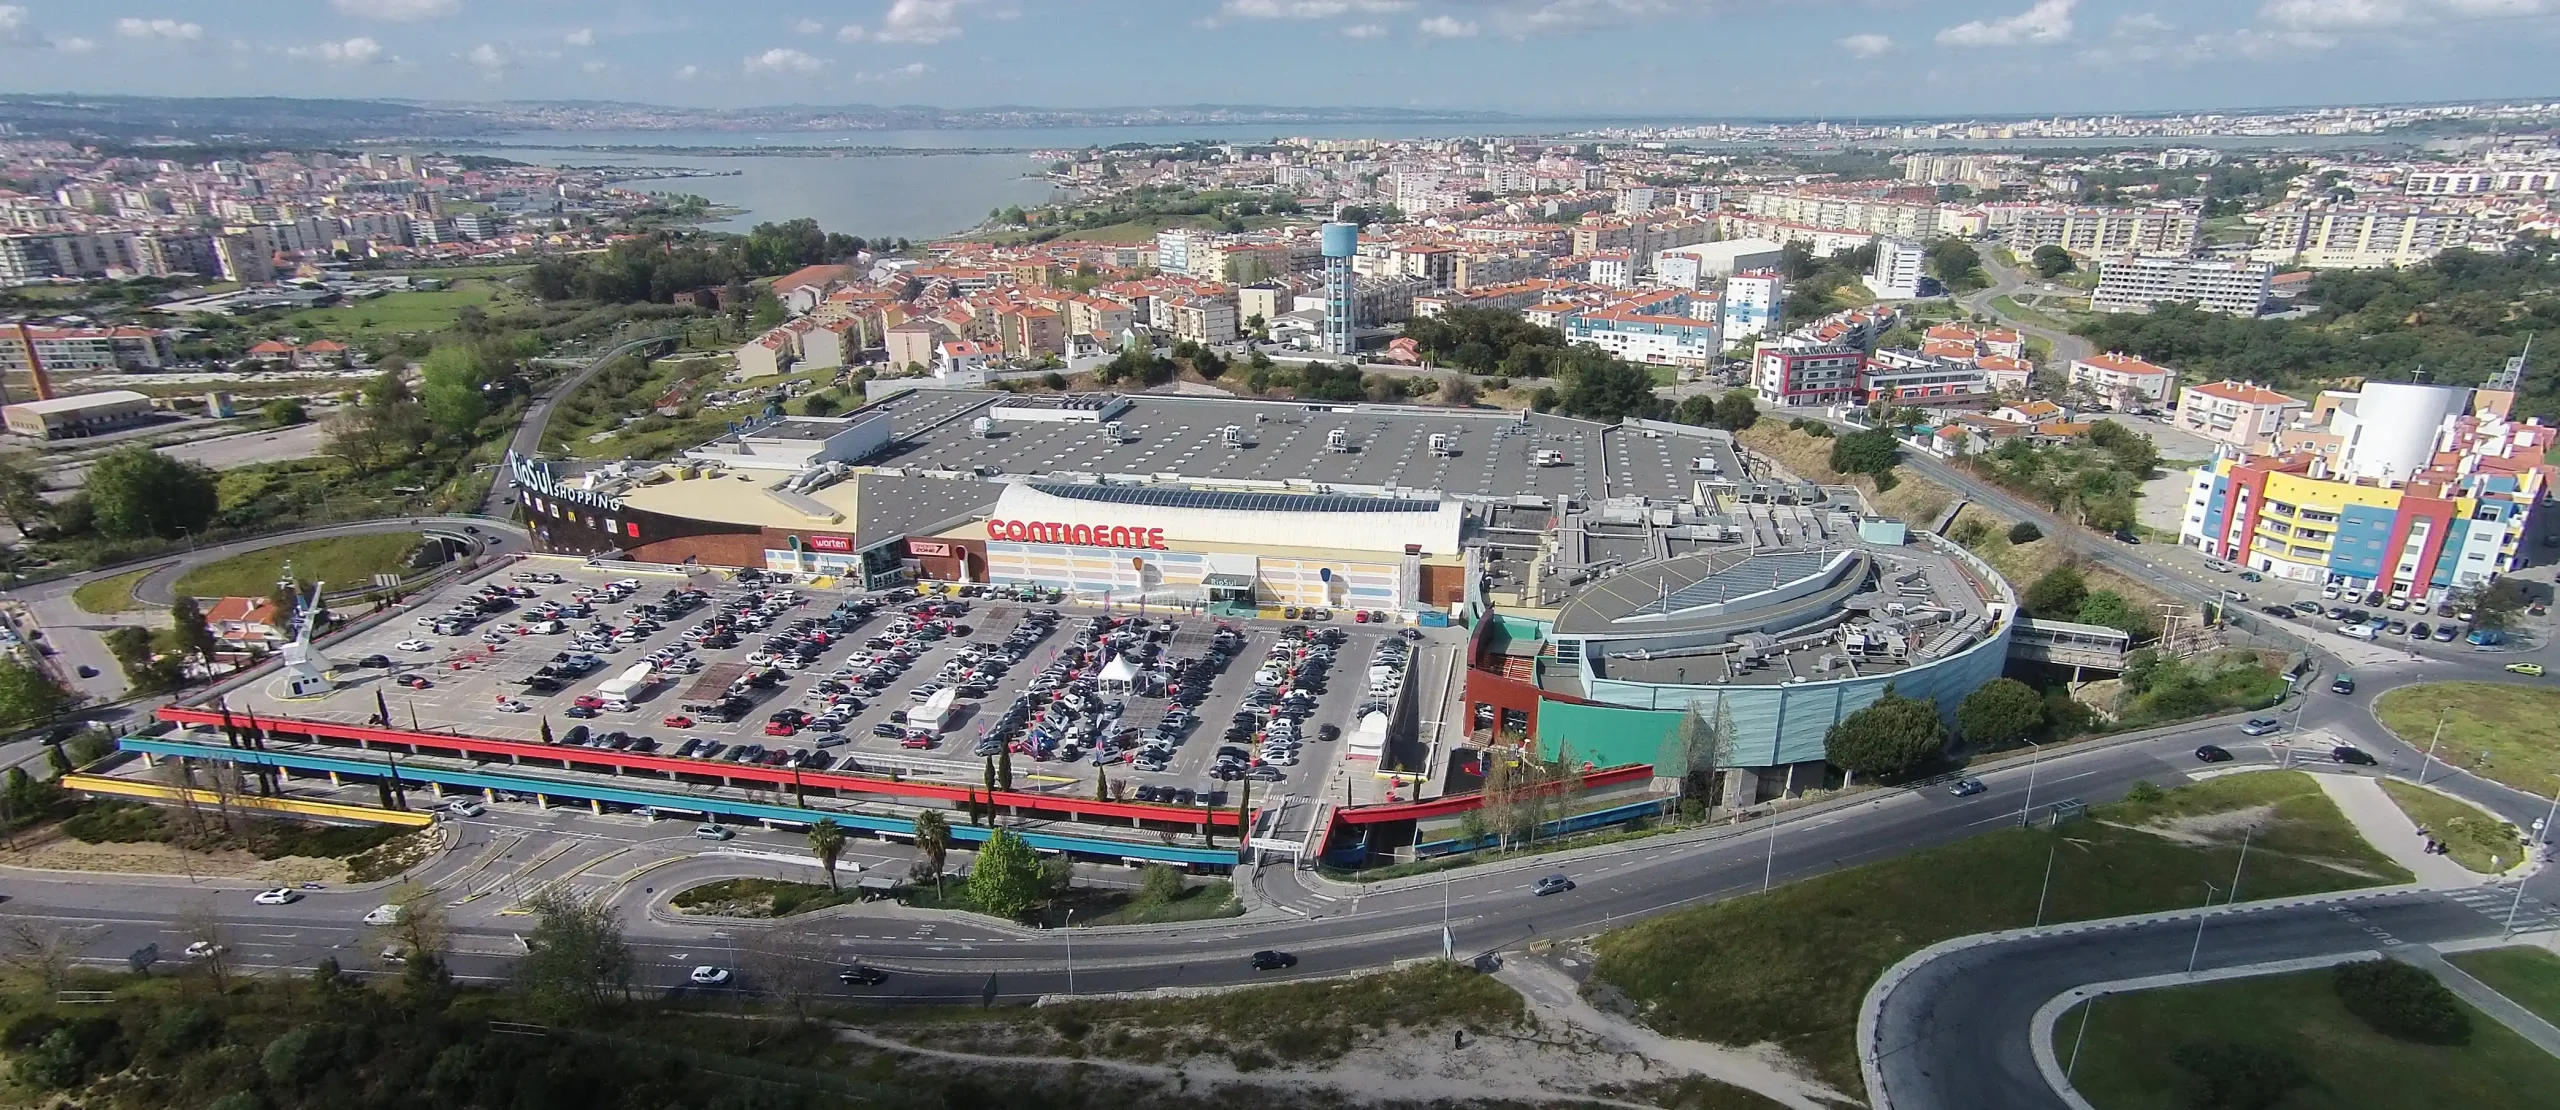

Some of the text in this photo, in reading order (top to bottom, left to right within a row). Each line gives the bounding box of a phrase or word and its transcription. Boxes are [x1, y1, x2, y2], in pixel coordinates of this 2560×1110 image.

[509, 449, 621, 512] RioSul SHOPPING
[987, 519, 1164, 549] CONTINENTE
[1211, 578, 1237, 586] RioSul
[2362, 926, 2403, 945] BUS
